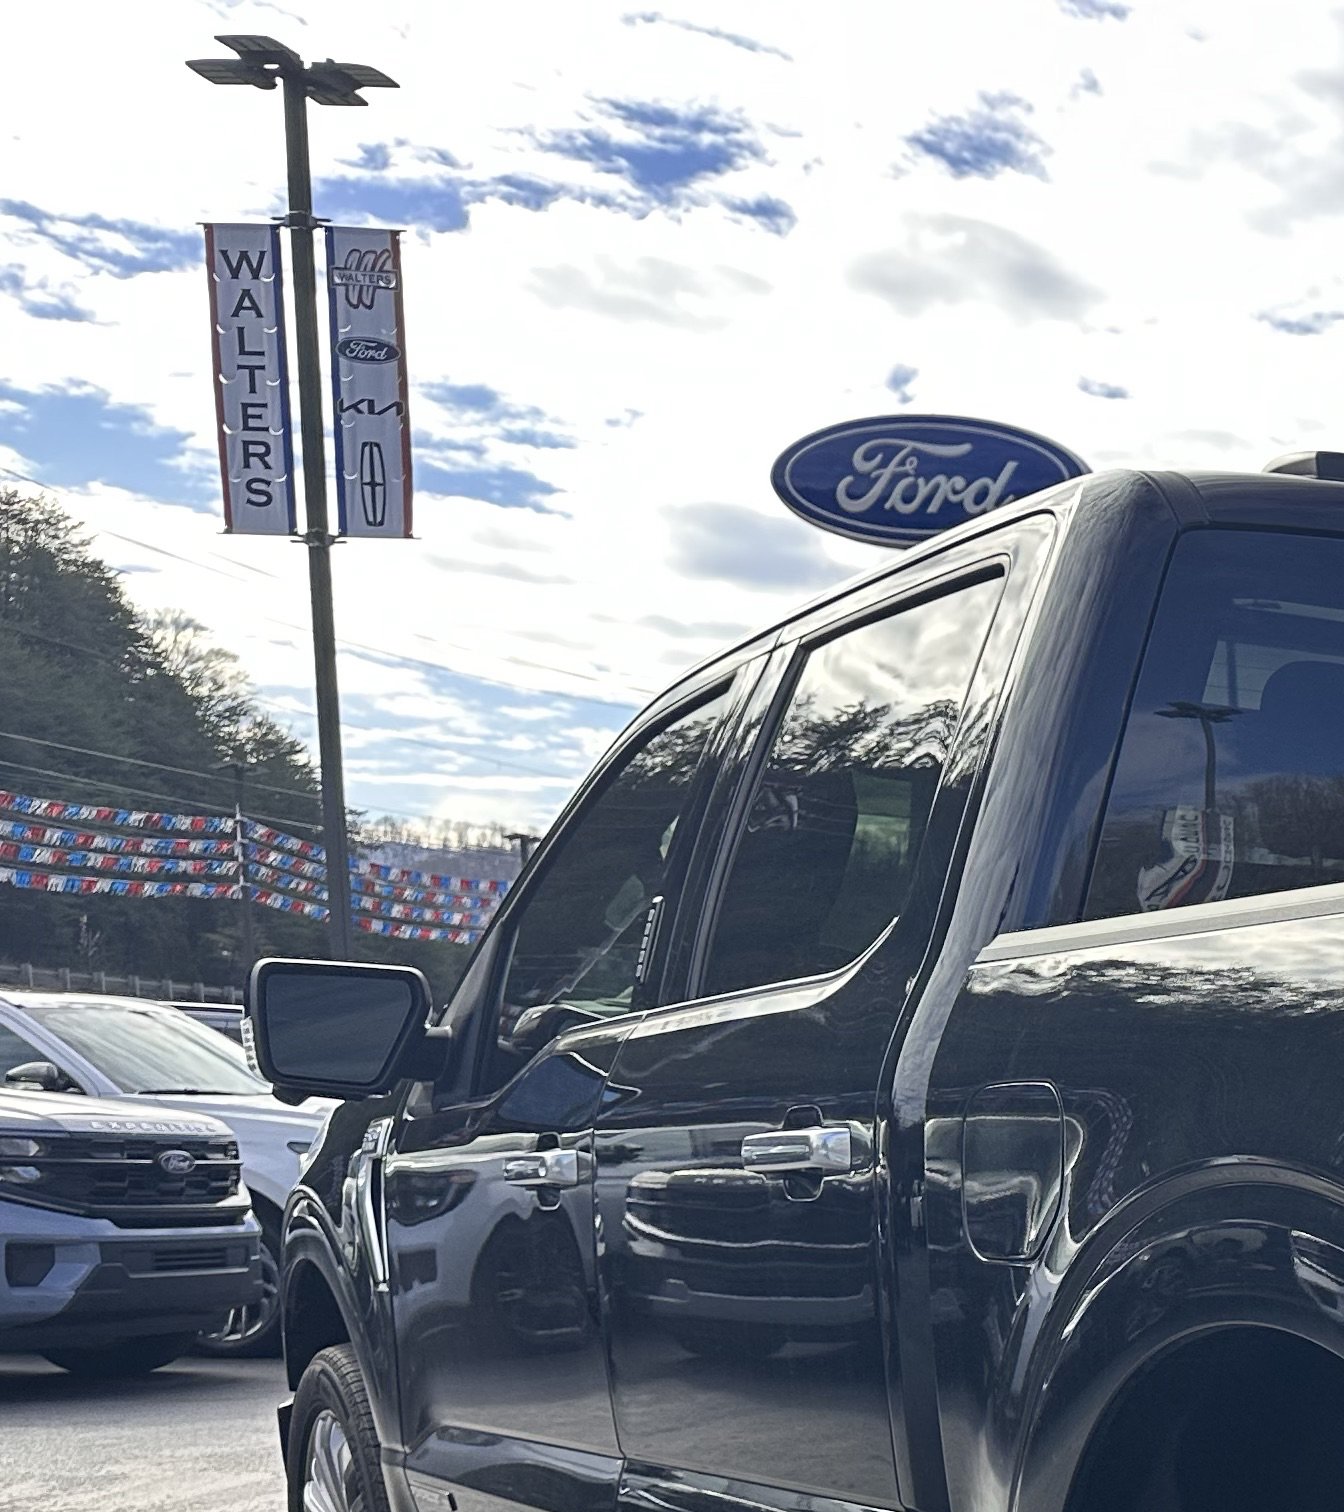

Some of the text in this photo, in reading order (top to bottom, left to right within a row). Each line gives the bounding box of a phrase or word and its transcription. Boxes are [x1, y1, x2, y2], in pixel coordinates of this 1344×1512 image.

[219, 249, 274, 507] WALTERS
[345, 342, 387, 361] Ford
[836, 437, 1019, 514] Ford
